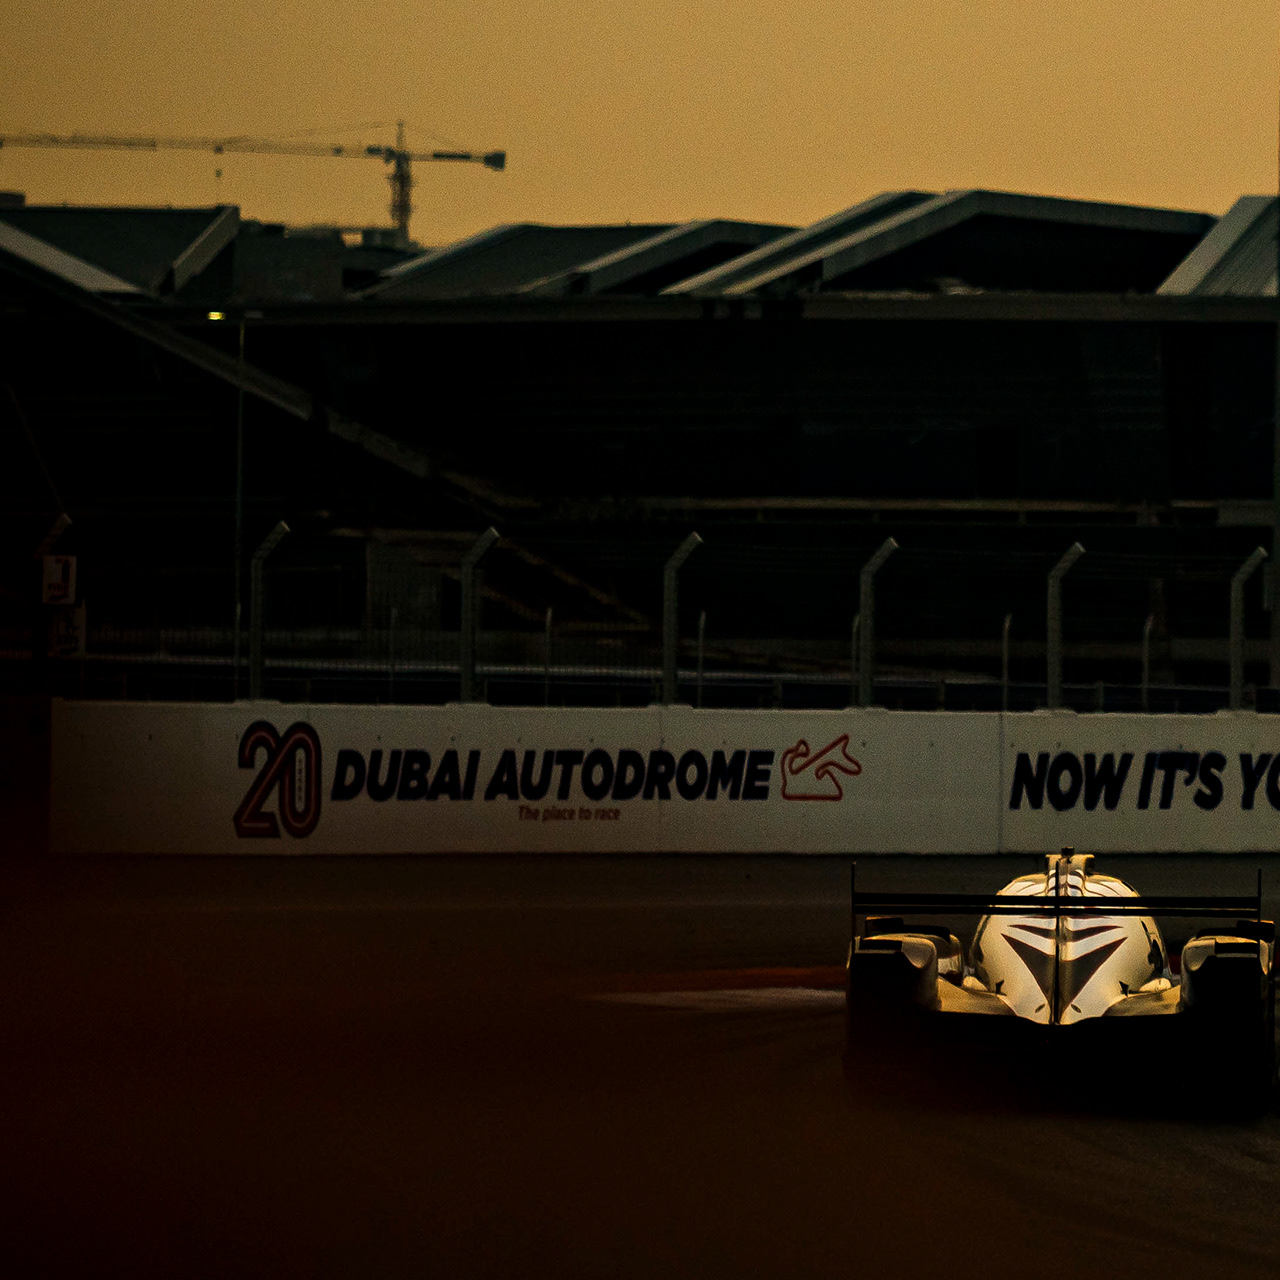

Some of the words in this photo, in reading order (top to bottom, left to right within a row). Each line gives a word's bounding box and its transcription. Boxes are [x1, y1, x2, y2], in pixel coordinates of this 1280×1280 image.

[232, 720, 323, 840] 20
[330, 749, 481, 802] DUBAI
[483, 749, 775, 802] AUTODROME
[1009, 752, 1134, 811] NOW
[1137, 752, 1227, 811] IT'S
[518, 806, 539, 821] The
[542, 806, 576, 822] place
[578, 807, 592, 821] to
[594, 808, 621, 821] race
